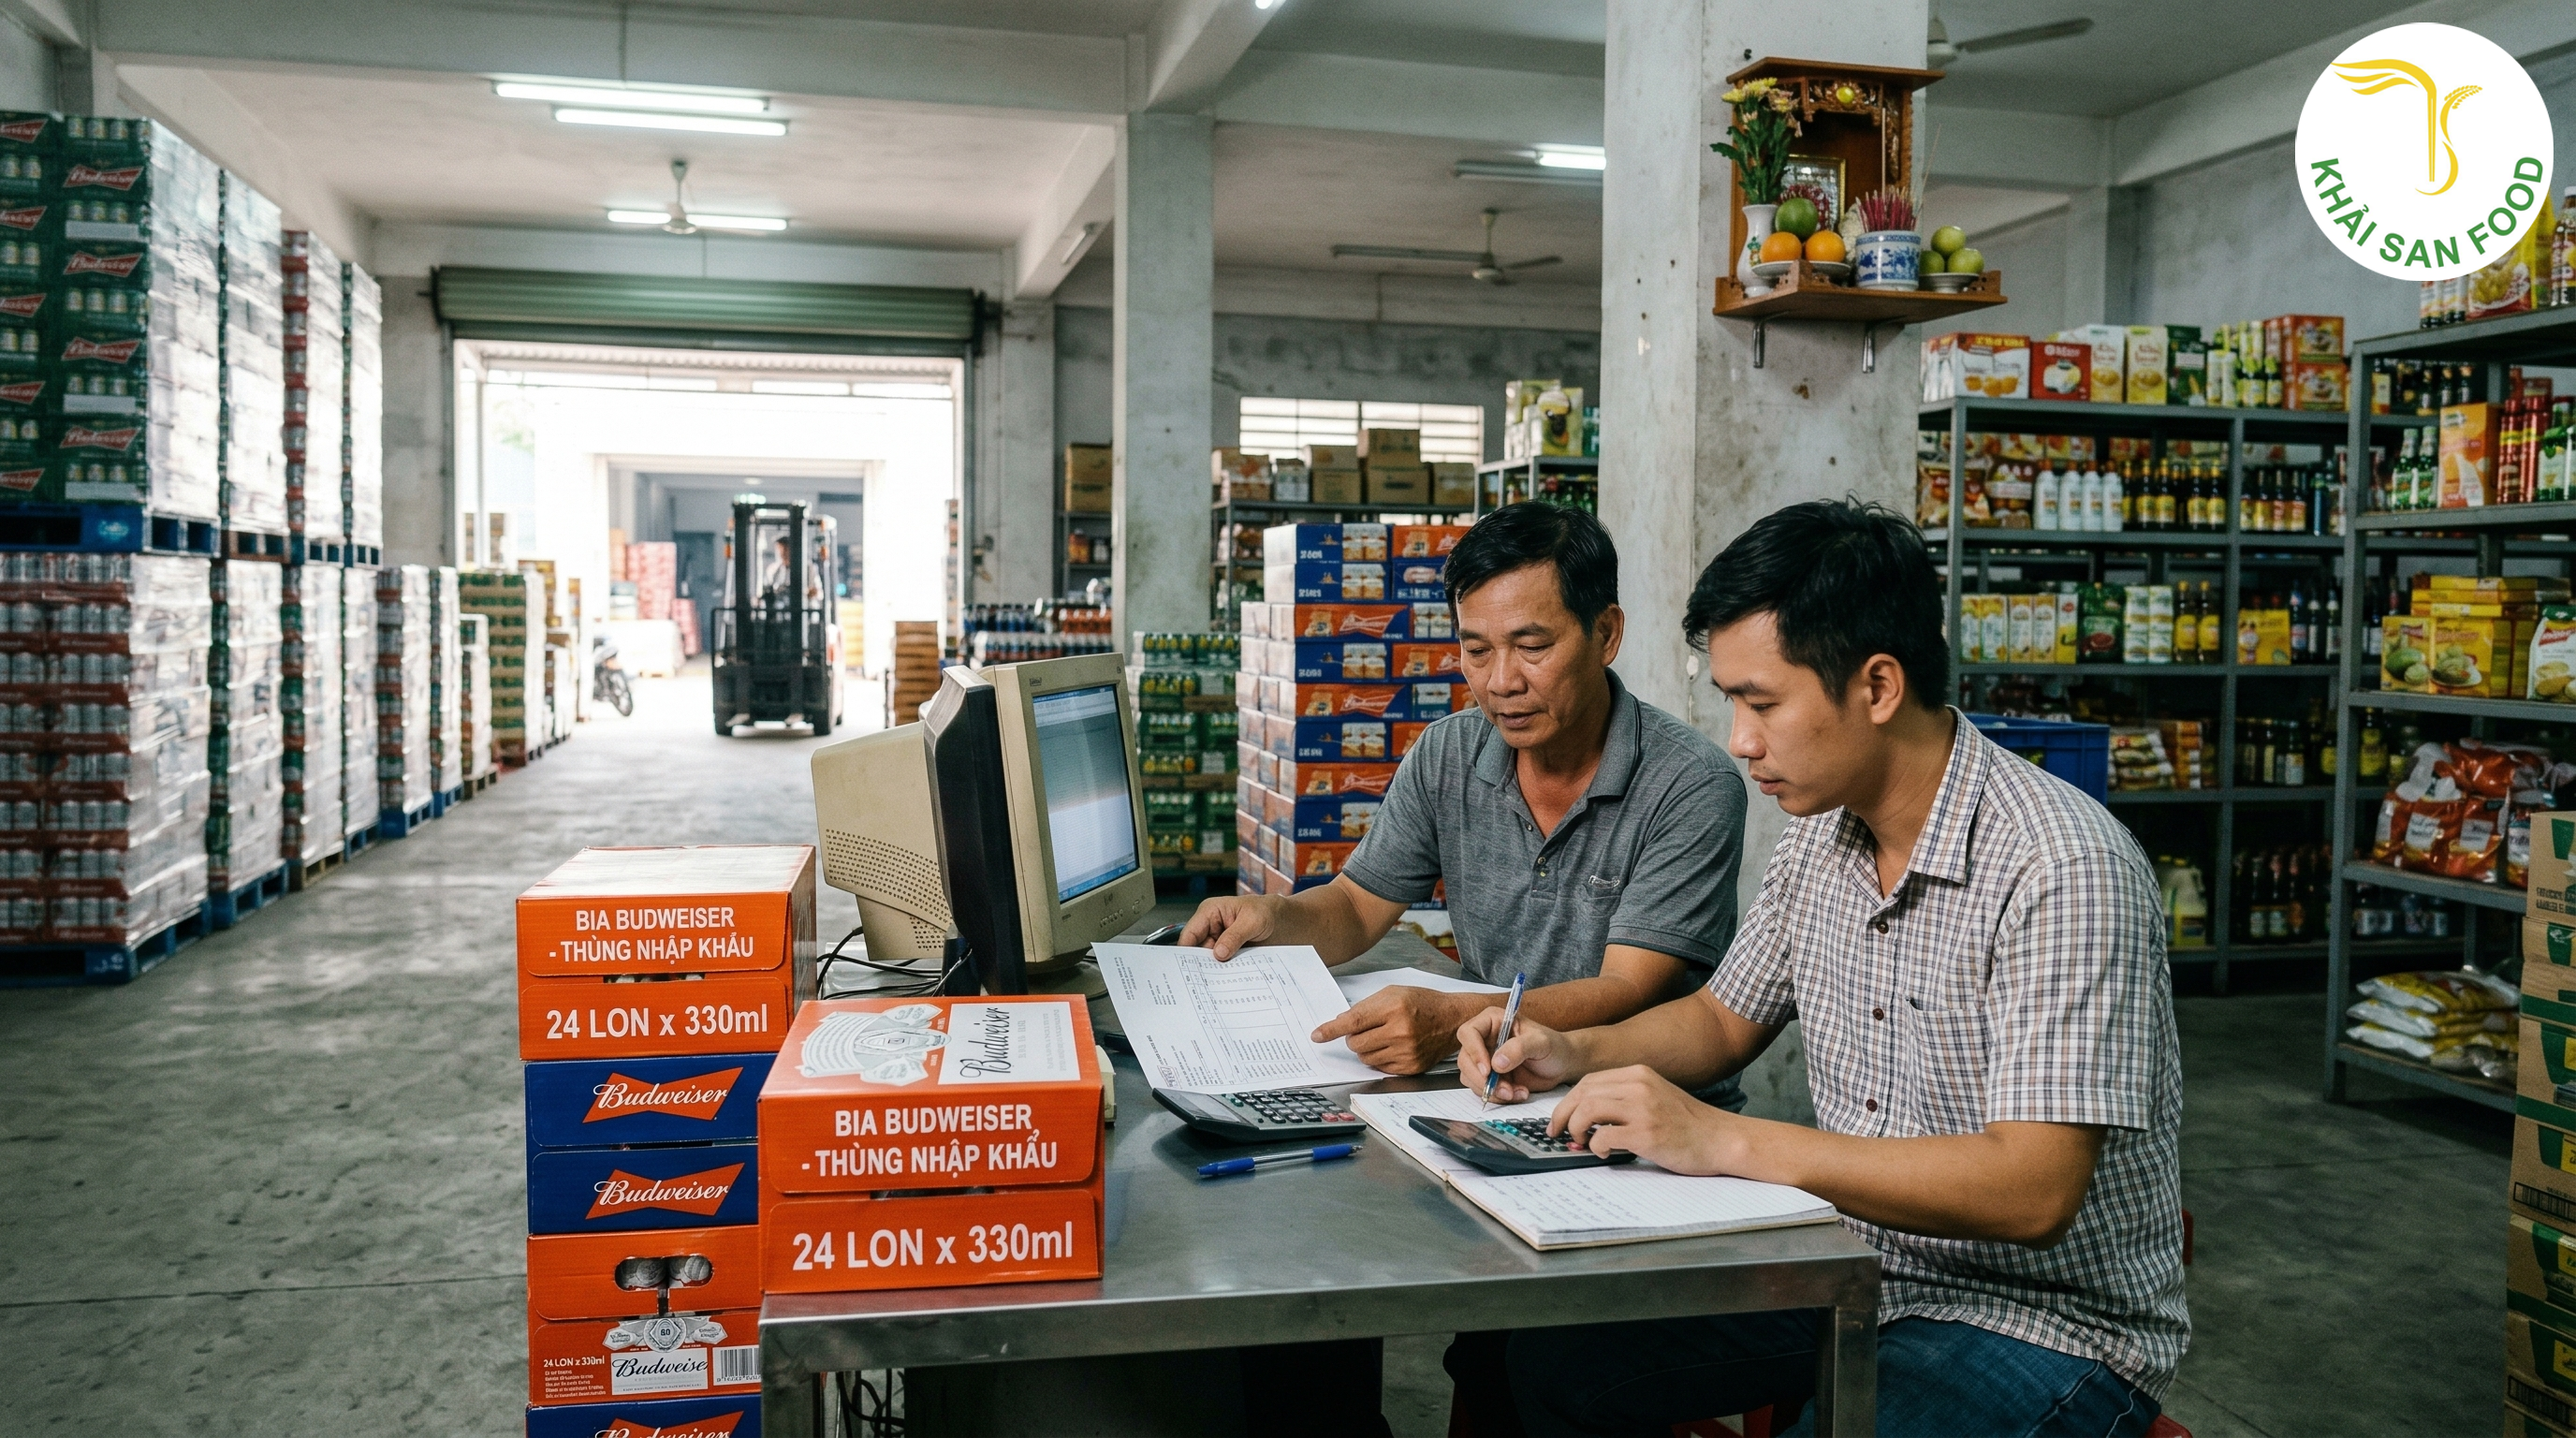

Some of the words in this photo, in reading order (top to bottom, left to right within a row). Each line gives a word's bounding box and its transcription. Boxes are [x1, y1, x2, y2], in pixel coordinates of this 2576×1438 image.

[577, 910, 611, 932] BIA
[616, 907, 736, 931] BUDWEISER
[561, 934, 632, 962] THÙNG
[637, 934, 694, 965] NHẬP
[546, 1009, 580, 1039] 24
[591, 1007, 650, 1038] LON
[659, 1014, 676, 1036] x
[684, 1003, 768, 1035] 330ml
[959, 1006, 1012, 1078] Budweiser
[593, 1082, 728, 1109] Budweiser
[835, 1109, 878, 1137] BIA
[885, 1104, 1032, 1135] BUDWEISER
[814, 1141, 903, 1177] THÙNG
[911, 1138, 980, 1179] NHẬP
[988, 1129, 1058, 1170] KHẨU
[593, 1180, 729, 1206] Budweiser
[792, 1231, 835, 1270] 24
[847, 1228, 923, 1269] LON
[935, 1236, 957, 1265] x
[968, 1221, 1073, 1263] 330ml
[543, 1358, 553, 1368] 24
[554, 1357, 574, 1367] LON
[611, 1357, 709, 1377] Budweise
